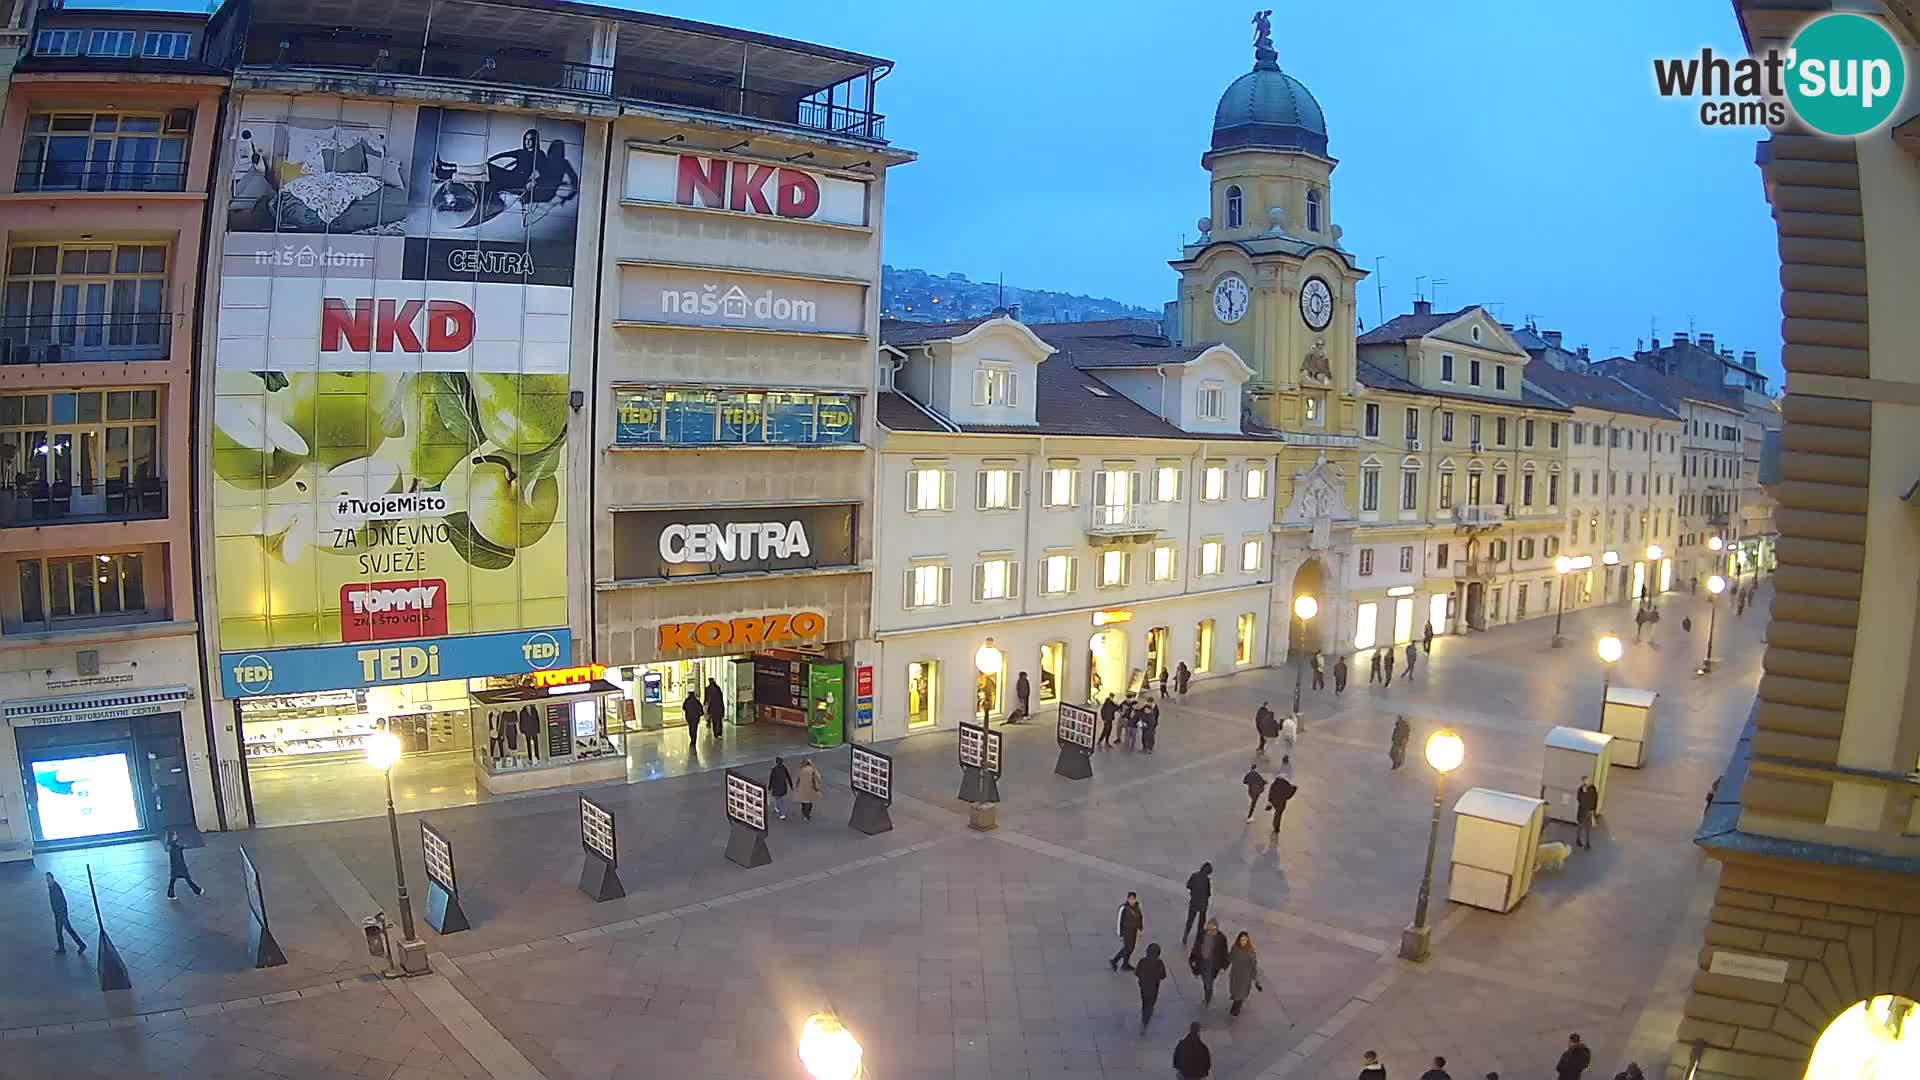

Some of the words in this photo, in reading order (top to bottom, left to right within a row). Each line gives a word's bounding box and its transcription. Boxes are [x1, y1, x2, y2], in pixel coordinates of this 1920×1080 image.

[677, 154, 820, 219] NKD
[255, 246, 293, 267] naš
[319, 247, 365, 268] dom
[448, 249, 535, 275] CENTRA
[661, 284, 718, 314] naš
[754, 290, 816, 322] dom
[320, 297, 476, 352] NKD
[619, 407, 657, 424] TEDi
[723, 408, 760, 425] TEDi
[338, 496, 446, 516] #TvojeMisto
[333, 528, 357, 548] ZA
[365, 524, 450, 547] DNEVNO
[659, 520, 810, 564] CENTRA
[359, 547, 426, 574] SVJEŽE
[348, 586, 439, 614] TOMMY
[379, 613, 400, 625] ŠTO
[659, 612, 825, 651] KORZO
[358, 645, 440, 682] TEDi
[522, 641, 560, 661] TEDi
[233, 664, 273, 683] TEDi
[75, 708, 129, 722] INFORMATIVNI
[131, 704, 162, 717] CENTAR
